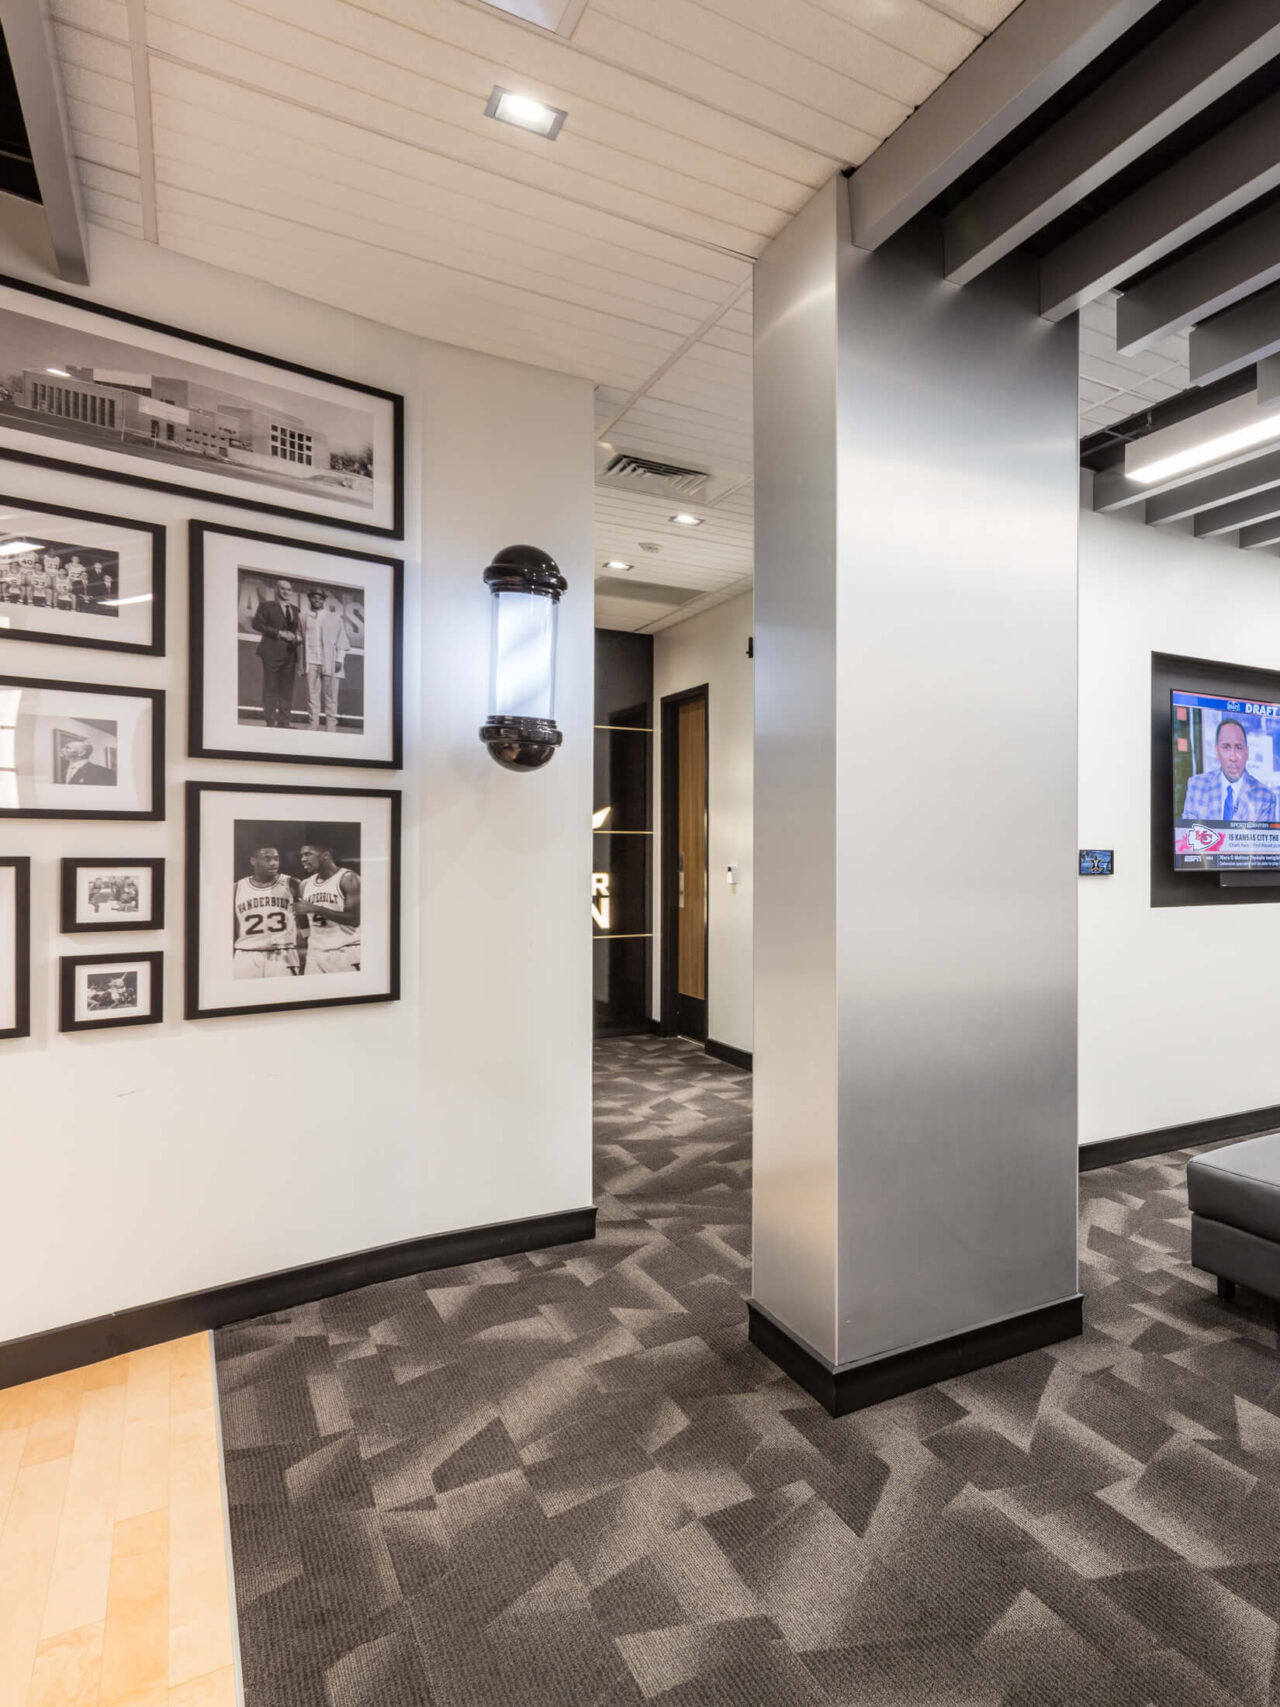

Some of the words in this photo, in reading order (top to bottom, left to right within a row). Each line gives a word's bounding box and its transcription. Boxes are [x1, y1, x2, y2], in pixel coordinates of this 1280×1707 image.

[1244, 703, 1279, 717] DRAFT
[1269, 834, 1279, 842] THE
[244, 911, 288, 935] 23
